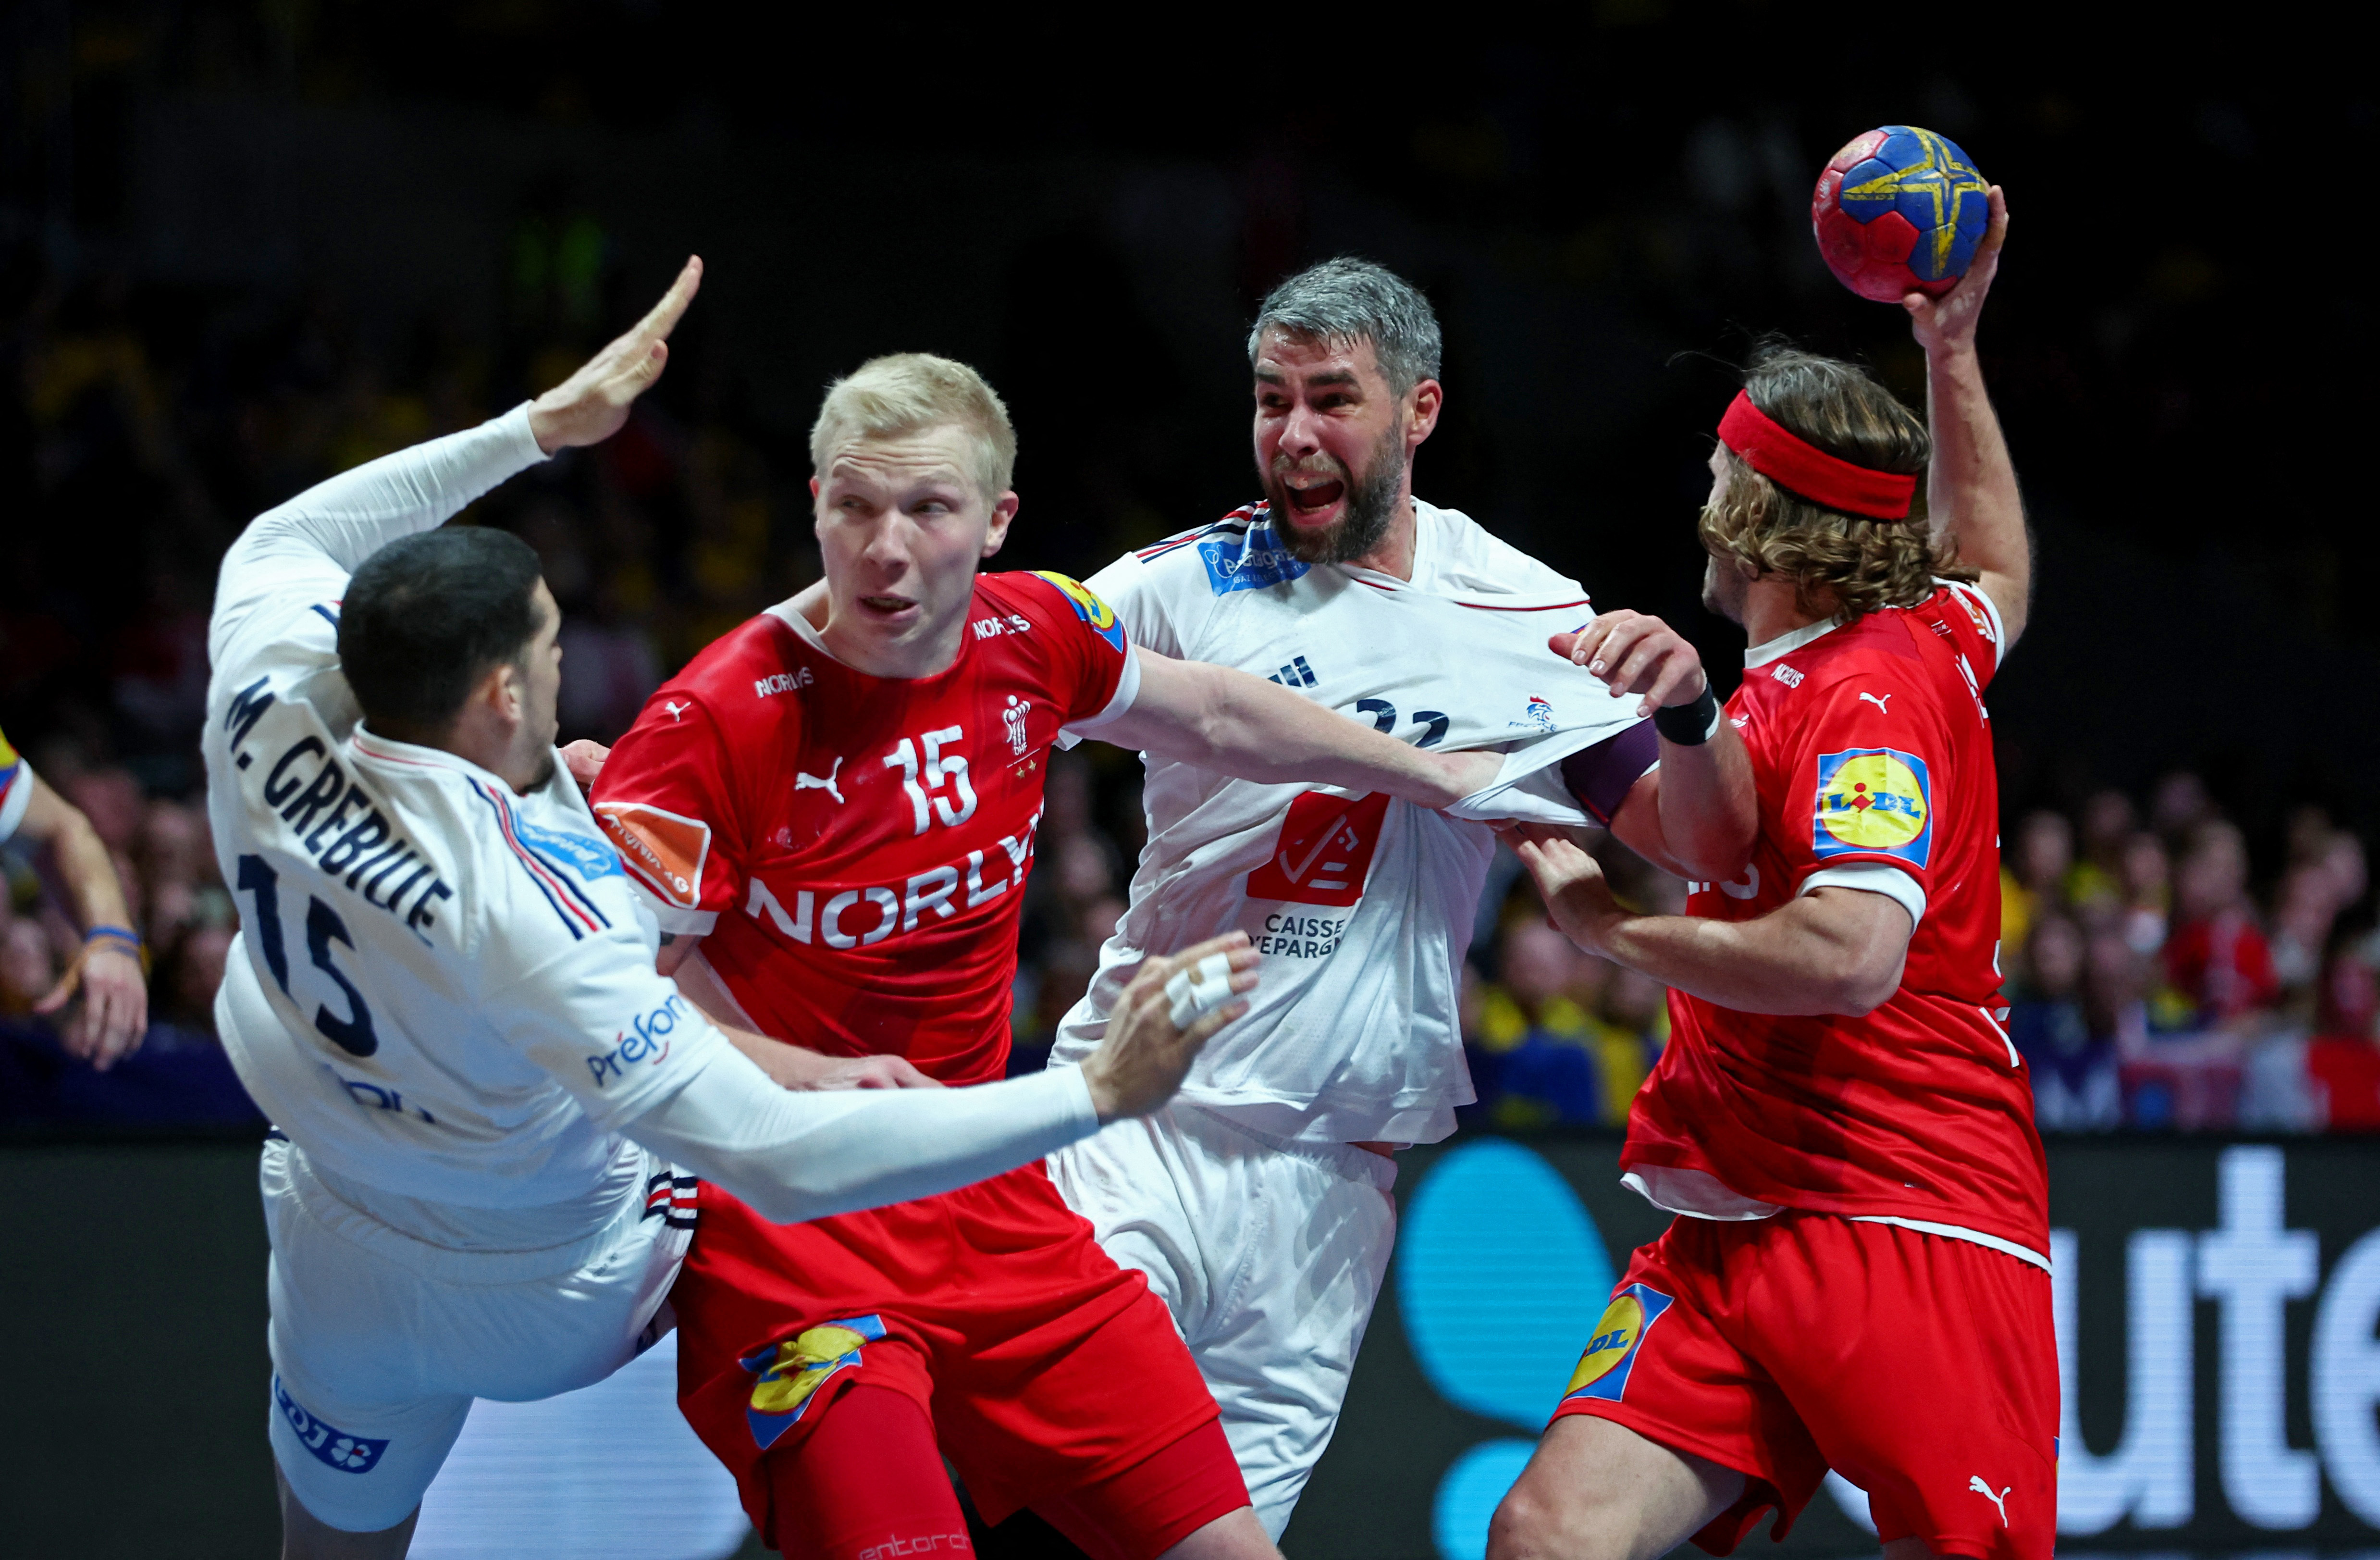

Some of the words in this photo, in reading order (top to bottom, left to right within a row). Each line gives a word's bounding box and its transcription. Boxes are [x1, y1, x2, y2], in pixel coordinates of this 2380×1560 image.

[224, 675, 277, 771] M.
[1013, 742, 1028, 756] DHF
[883, 724, 977, 836] 15
[238, 854, 378, 1058] 15
[1265, 914, 1345, 938] CAISSE
[587, 994, 688, 1088] Préfon
